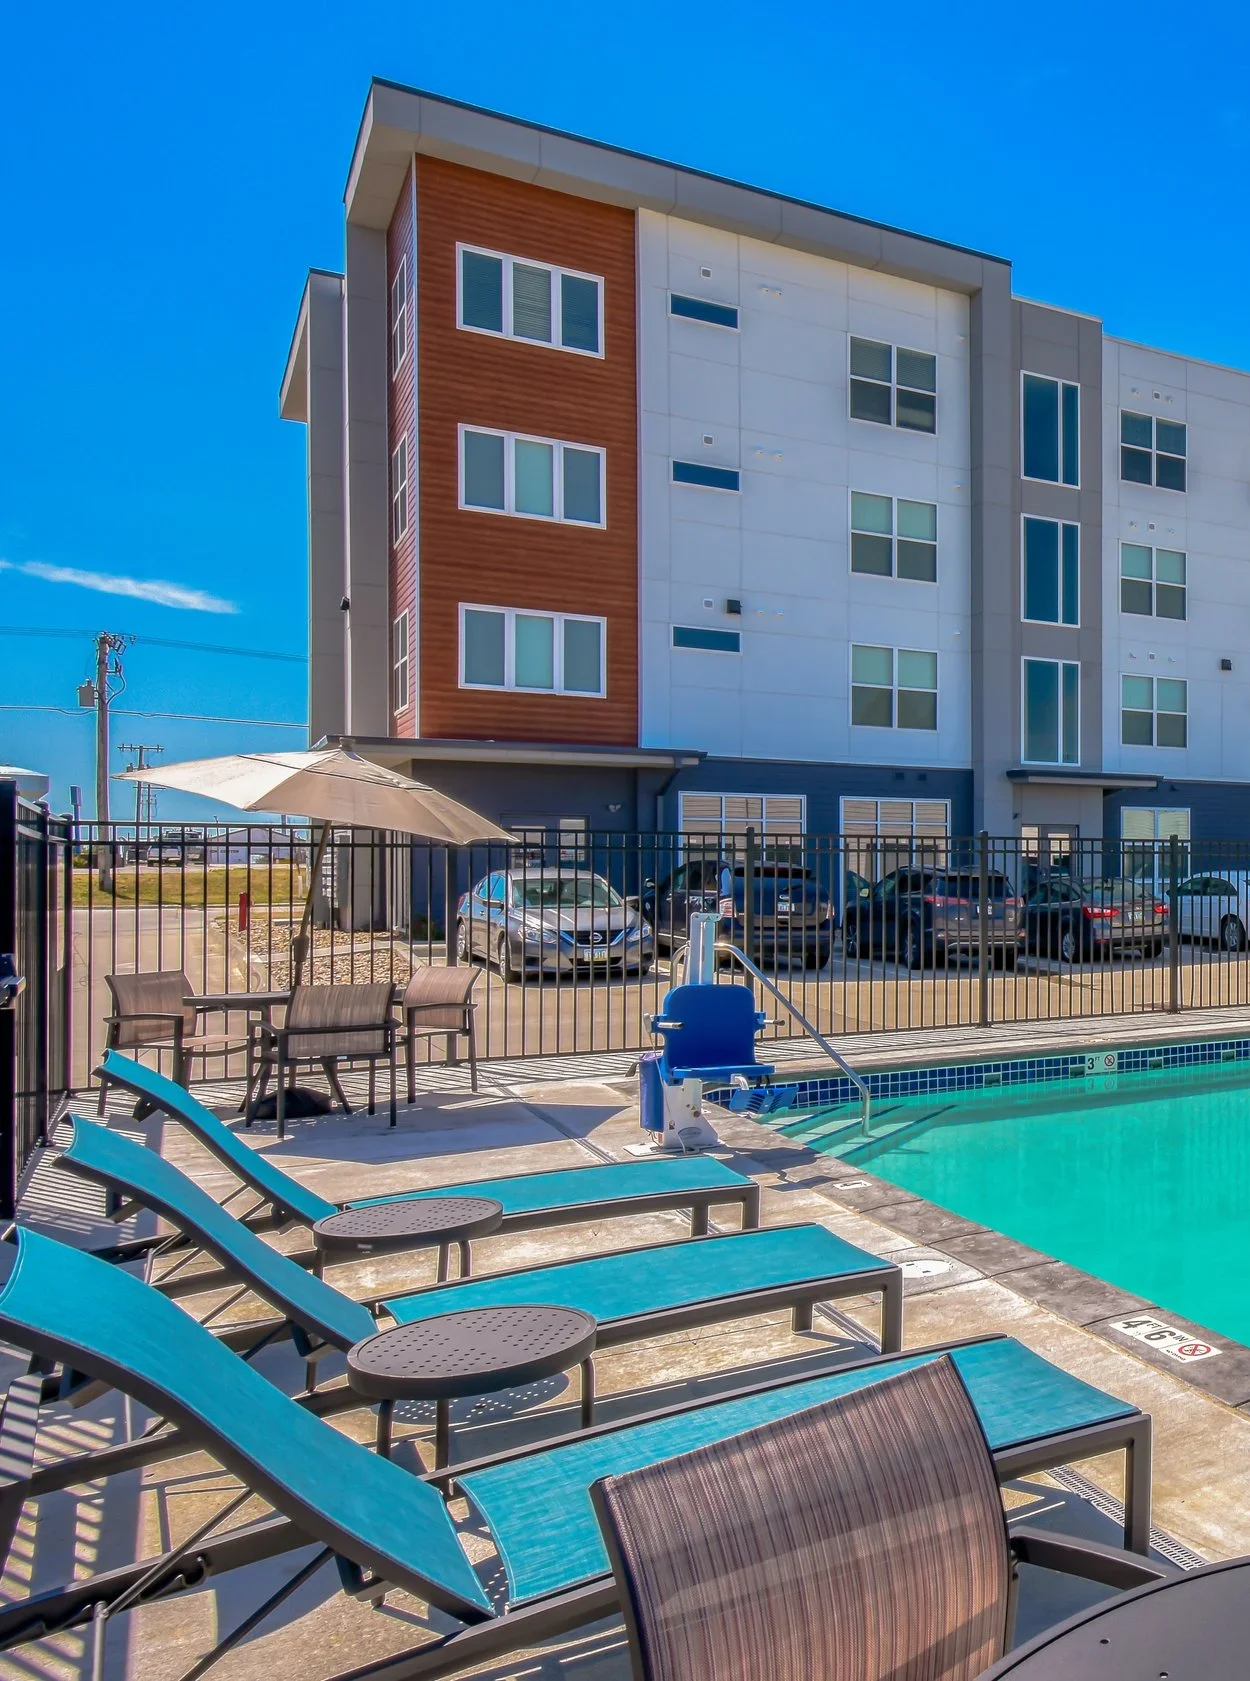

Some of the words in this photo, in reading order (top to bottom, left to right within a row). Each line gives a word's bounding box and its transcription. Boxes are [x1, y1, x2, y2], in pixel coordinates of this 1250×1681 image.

[1087, 1057, 1095, 1070] 3
[1122, 1320, 1152, 1330] 4
[1144, 1330, 1177, 1341] 6
